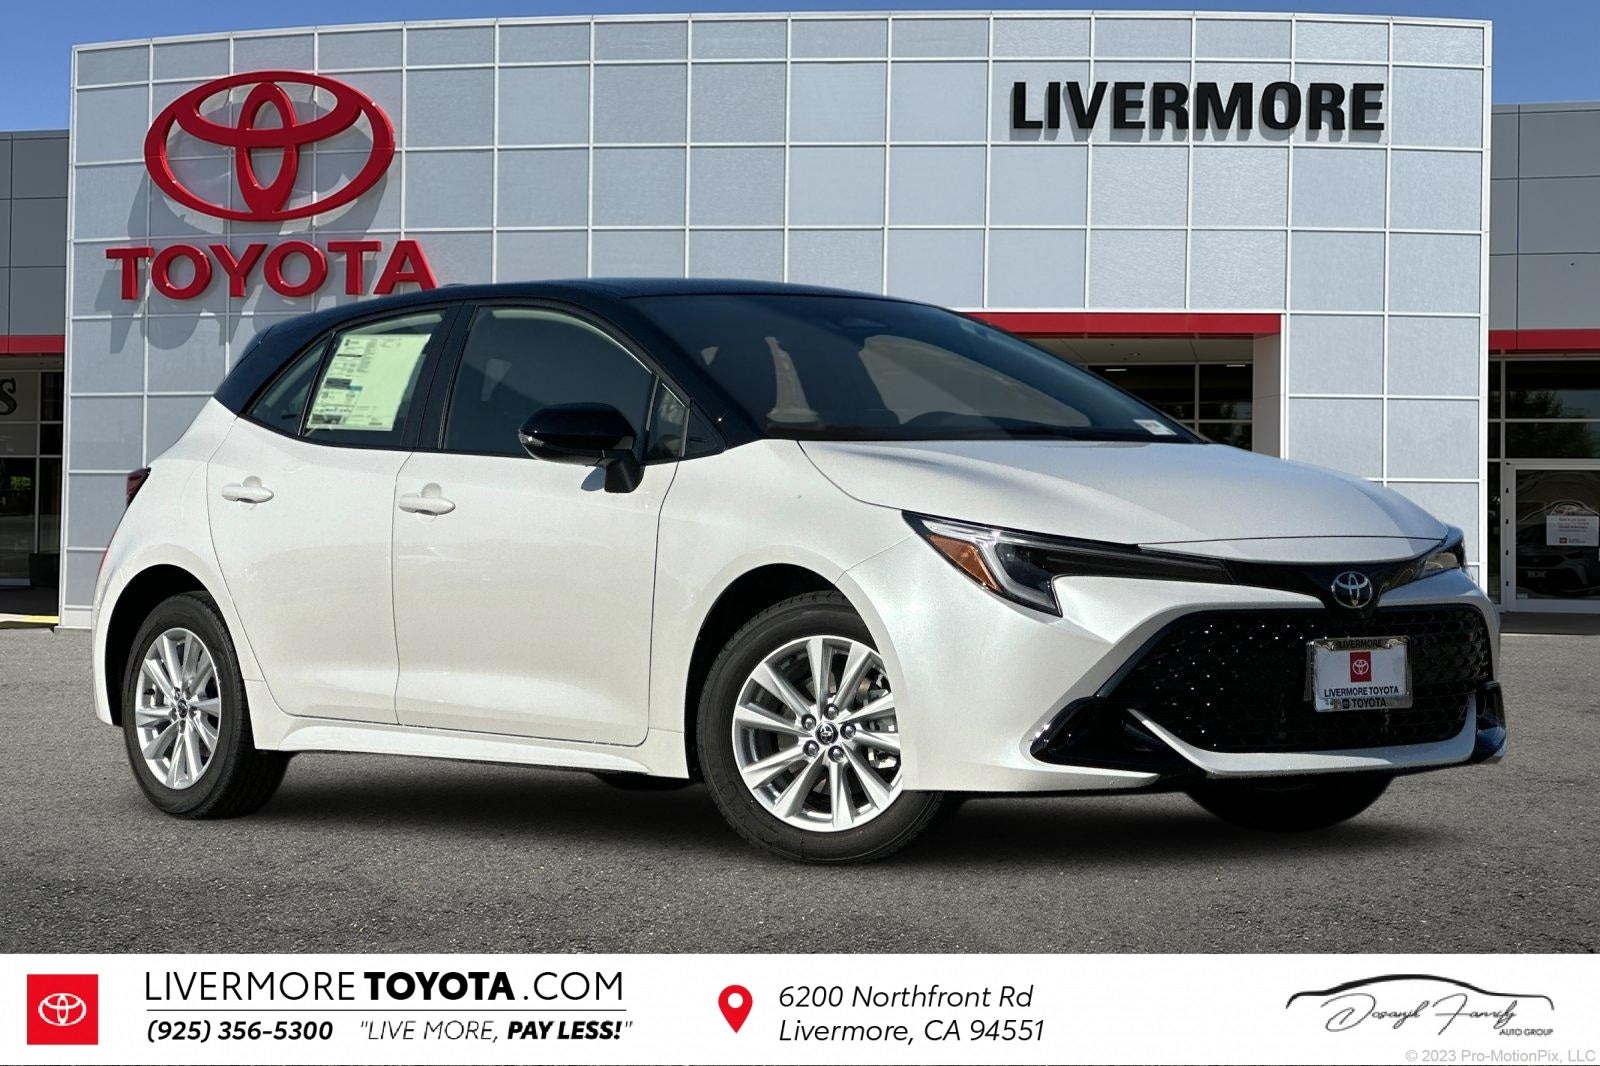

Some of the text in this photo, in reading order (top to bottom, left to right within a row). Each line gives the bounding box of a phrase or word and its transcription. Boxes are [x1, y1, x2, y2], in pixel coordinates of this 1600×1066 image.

[1012, 80, 1385, 131] LIVERMORE
[106, 239, 437, 300] TOYOTA
[1339, 639, 1381, 648] LIVERMORE
[1324, 686, 1399, 697] LIVERMORE TOYOTA
[1351, 698, 1387, 708] TOYOTA
